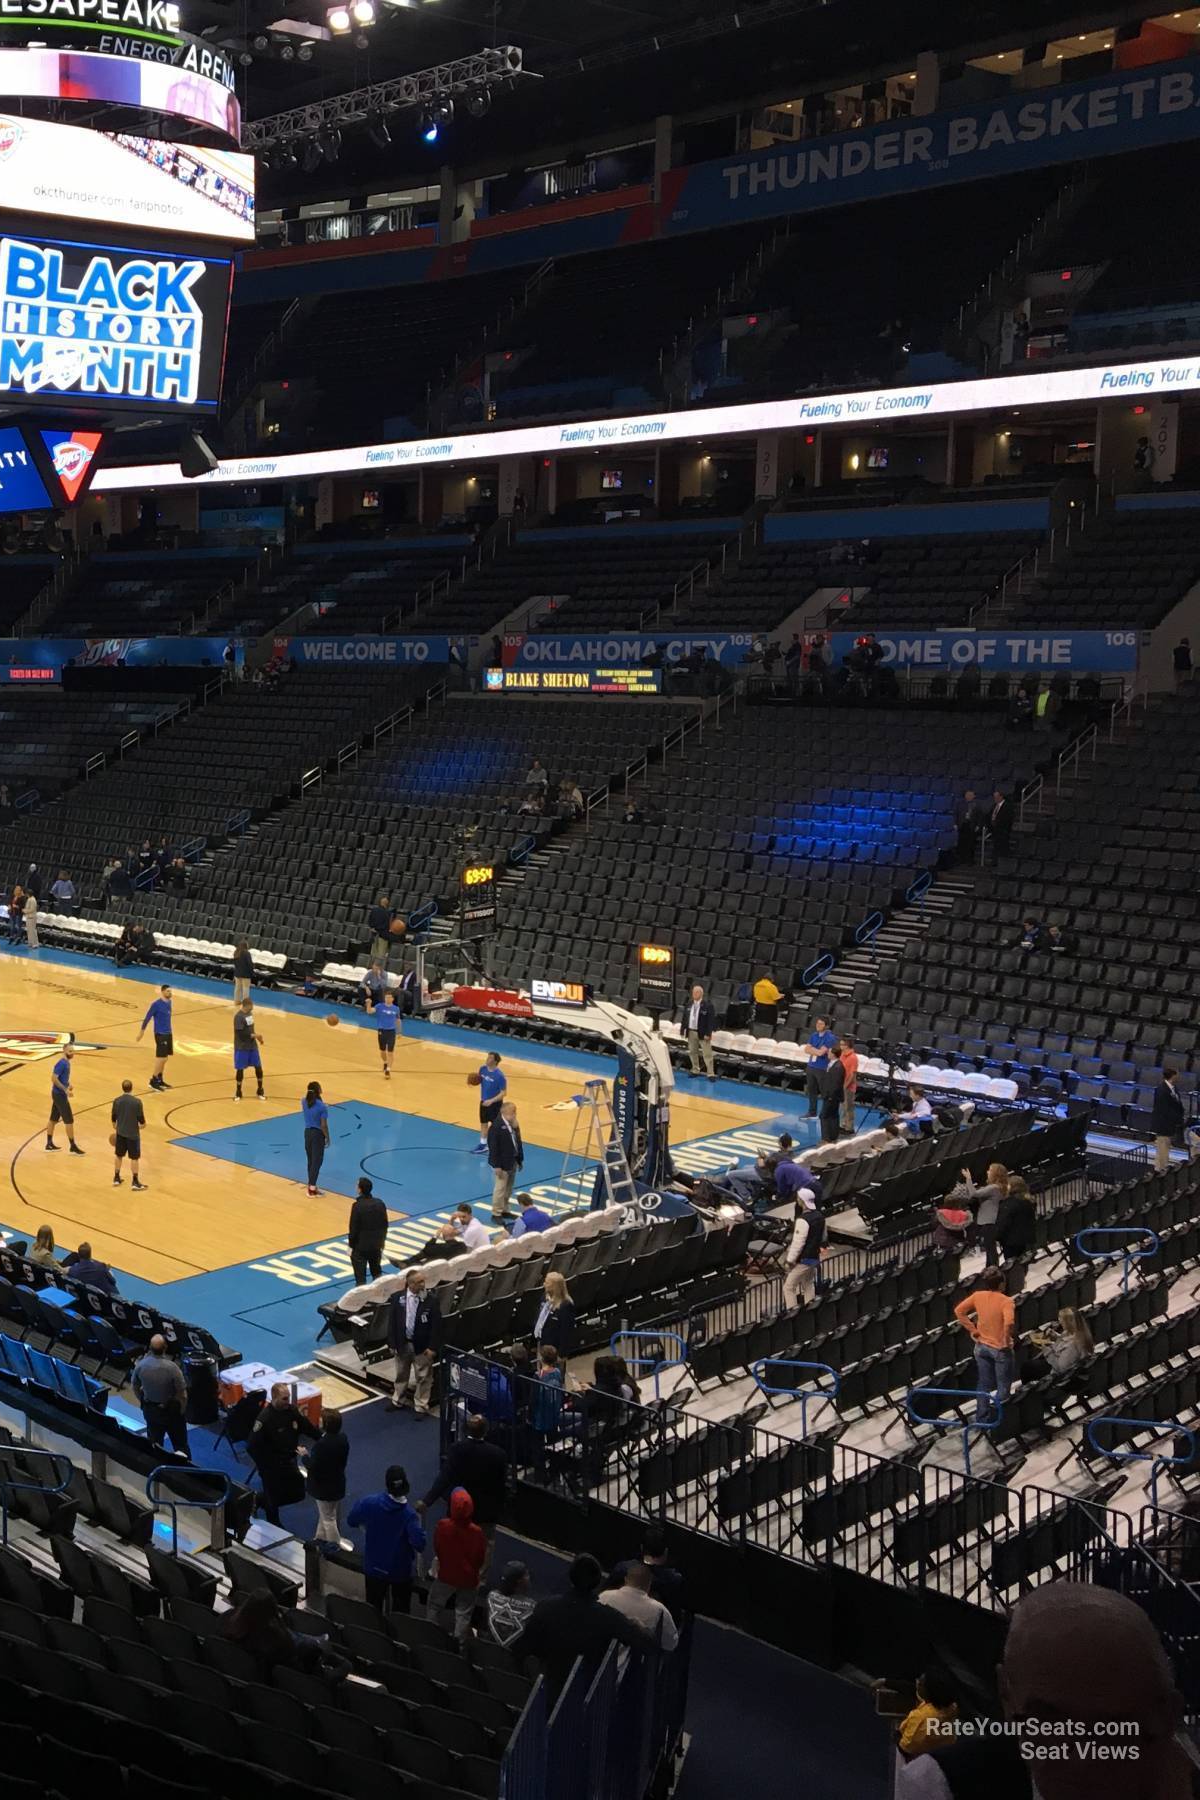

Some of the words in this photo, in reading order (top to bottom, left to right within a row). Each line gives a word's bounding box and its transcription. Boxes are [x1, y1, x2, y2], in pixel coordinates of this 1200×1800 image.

[99, 35, 178, 64] ENERGY
[183, 49, 236, 91] ARENA
[723, 126, 935, 200] THUNDER
[948, 72, 1200, 156] BASKETB
[5, 245, 205, 313] BLACK
[5, 307, 193, 348] HISTORY
[1101, 368, 1154, 389] Fueling
[1160, 366, 1191, 385] Your
[800, 401, 842, 418] Fueling
[846, 398, 870, 413] Your
[875, 392, 933, 411] Economy
[560, 426, 595, 442] Fueling
[598, 424, 618, 438] Your
[621, 420, 667, 436] Economy
[1158, 416, 1168, 456] 209
[366, 447, 394, 463] Fueling
[415, 443, 453, 458] Economy
[238, 461, 277, 478] Economy
[273, 638, 288, 648] 104
[447, 638, 464, 647] 14
[504, 637, 522, 647] 105
[730, 635, 752, 646] 105
[1104, 632, 1136, 646] 106
[303, 642, 396, 661] WELCOME
[402, 642, 429, 660] TO
[523, 640, 658, 662] OKLAHOMA
[854, 639, 942, 663] OME
[951, 639, 996, 663] OF
[1006, 639, 1072, 663] THE
[505, 672, 539, 687] BLAKE
[543, 673, 589, 687] SHELTON
[465, 868, 493, 885] 69:54
[475, 908, 494, 918] TISSOT
[652, 979, 671, 987] TISSOT
[111, 1301, 126, 1319] G
[137, 1309, 153, 1329] G
[187, 1331, 203, 1350] G
